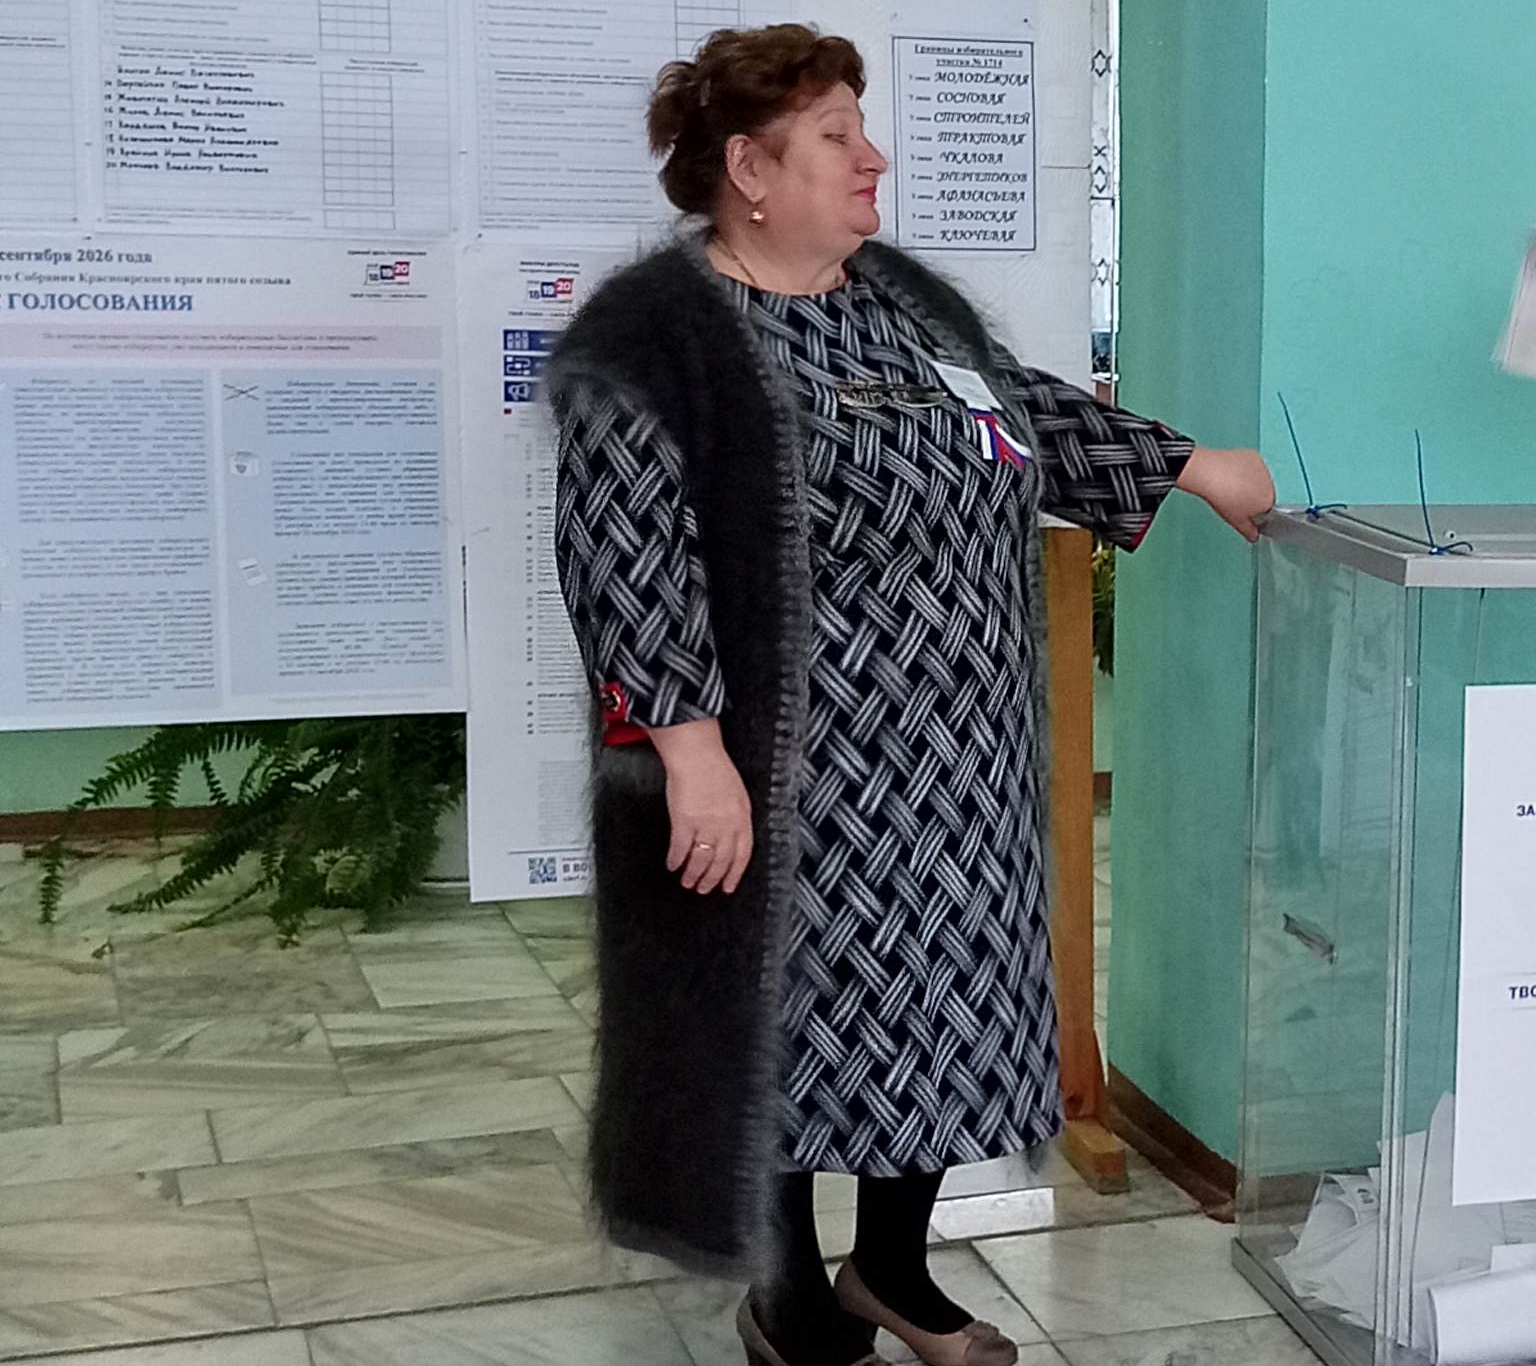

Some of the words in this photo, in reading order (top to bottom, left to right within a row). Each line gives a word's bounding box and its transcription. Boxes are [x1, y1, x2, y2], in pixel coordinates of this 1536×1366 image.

[937, 92, 1006, 105] СОСНОВАЯ
[934, 112, 1030, 125] СТРОИТЕЛЕЙ
[938, 132, 1026, 146] ТРАКТОВАЯ
[940, 152, 1003, 164] ЧКАЛОВА
[937, 171, 1027, 183] ЭНЕРГЕТИКОВ
[936, 190, 1025, 203] АФАНАСЬЕВА
[940, 210, 1017, 222] ЗАВОДСКАЯ
[940, 230, 1016, 242] КЛЮЧЕВАЯ
[77, 249, 114, 262] 2026
[118, 252, 153, 263] года
[8, 293, 193, 311] ГОЛОСОВАНИЯ
